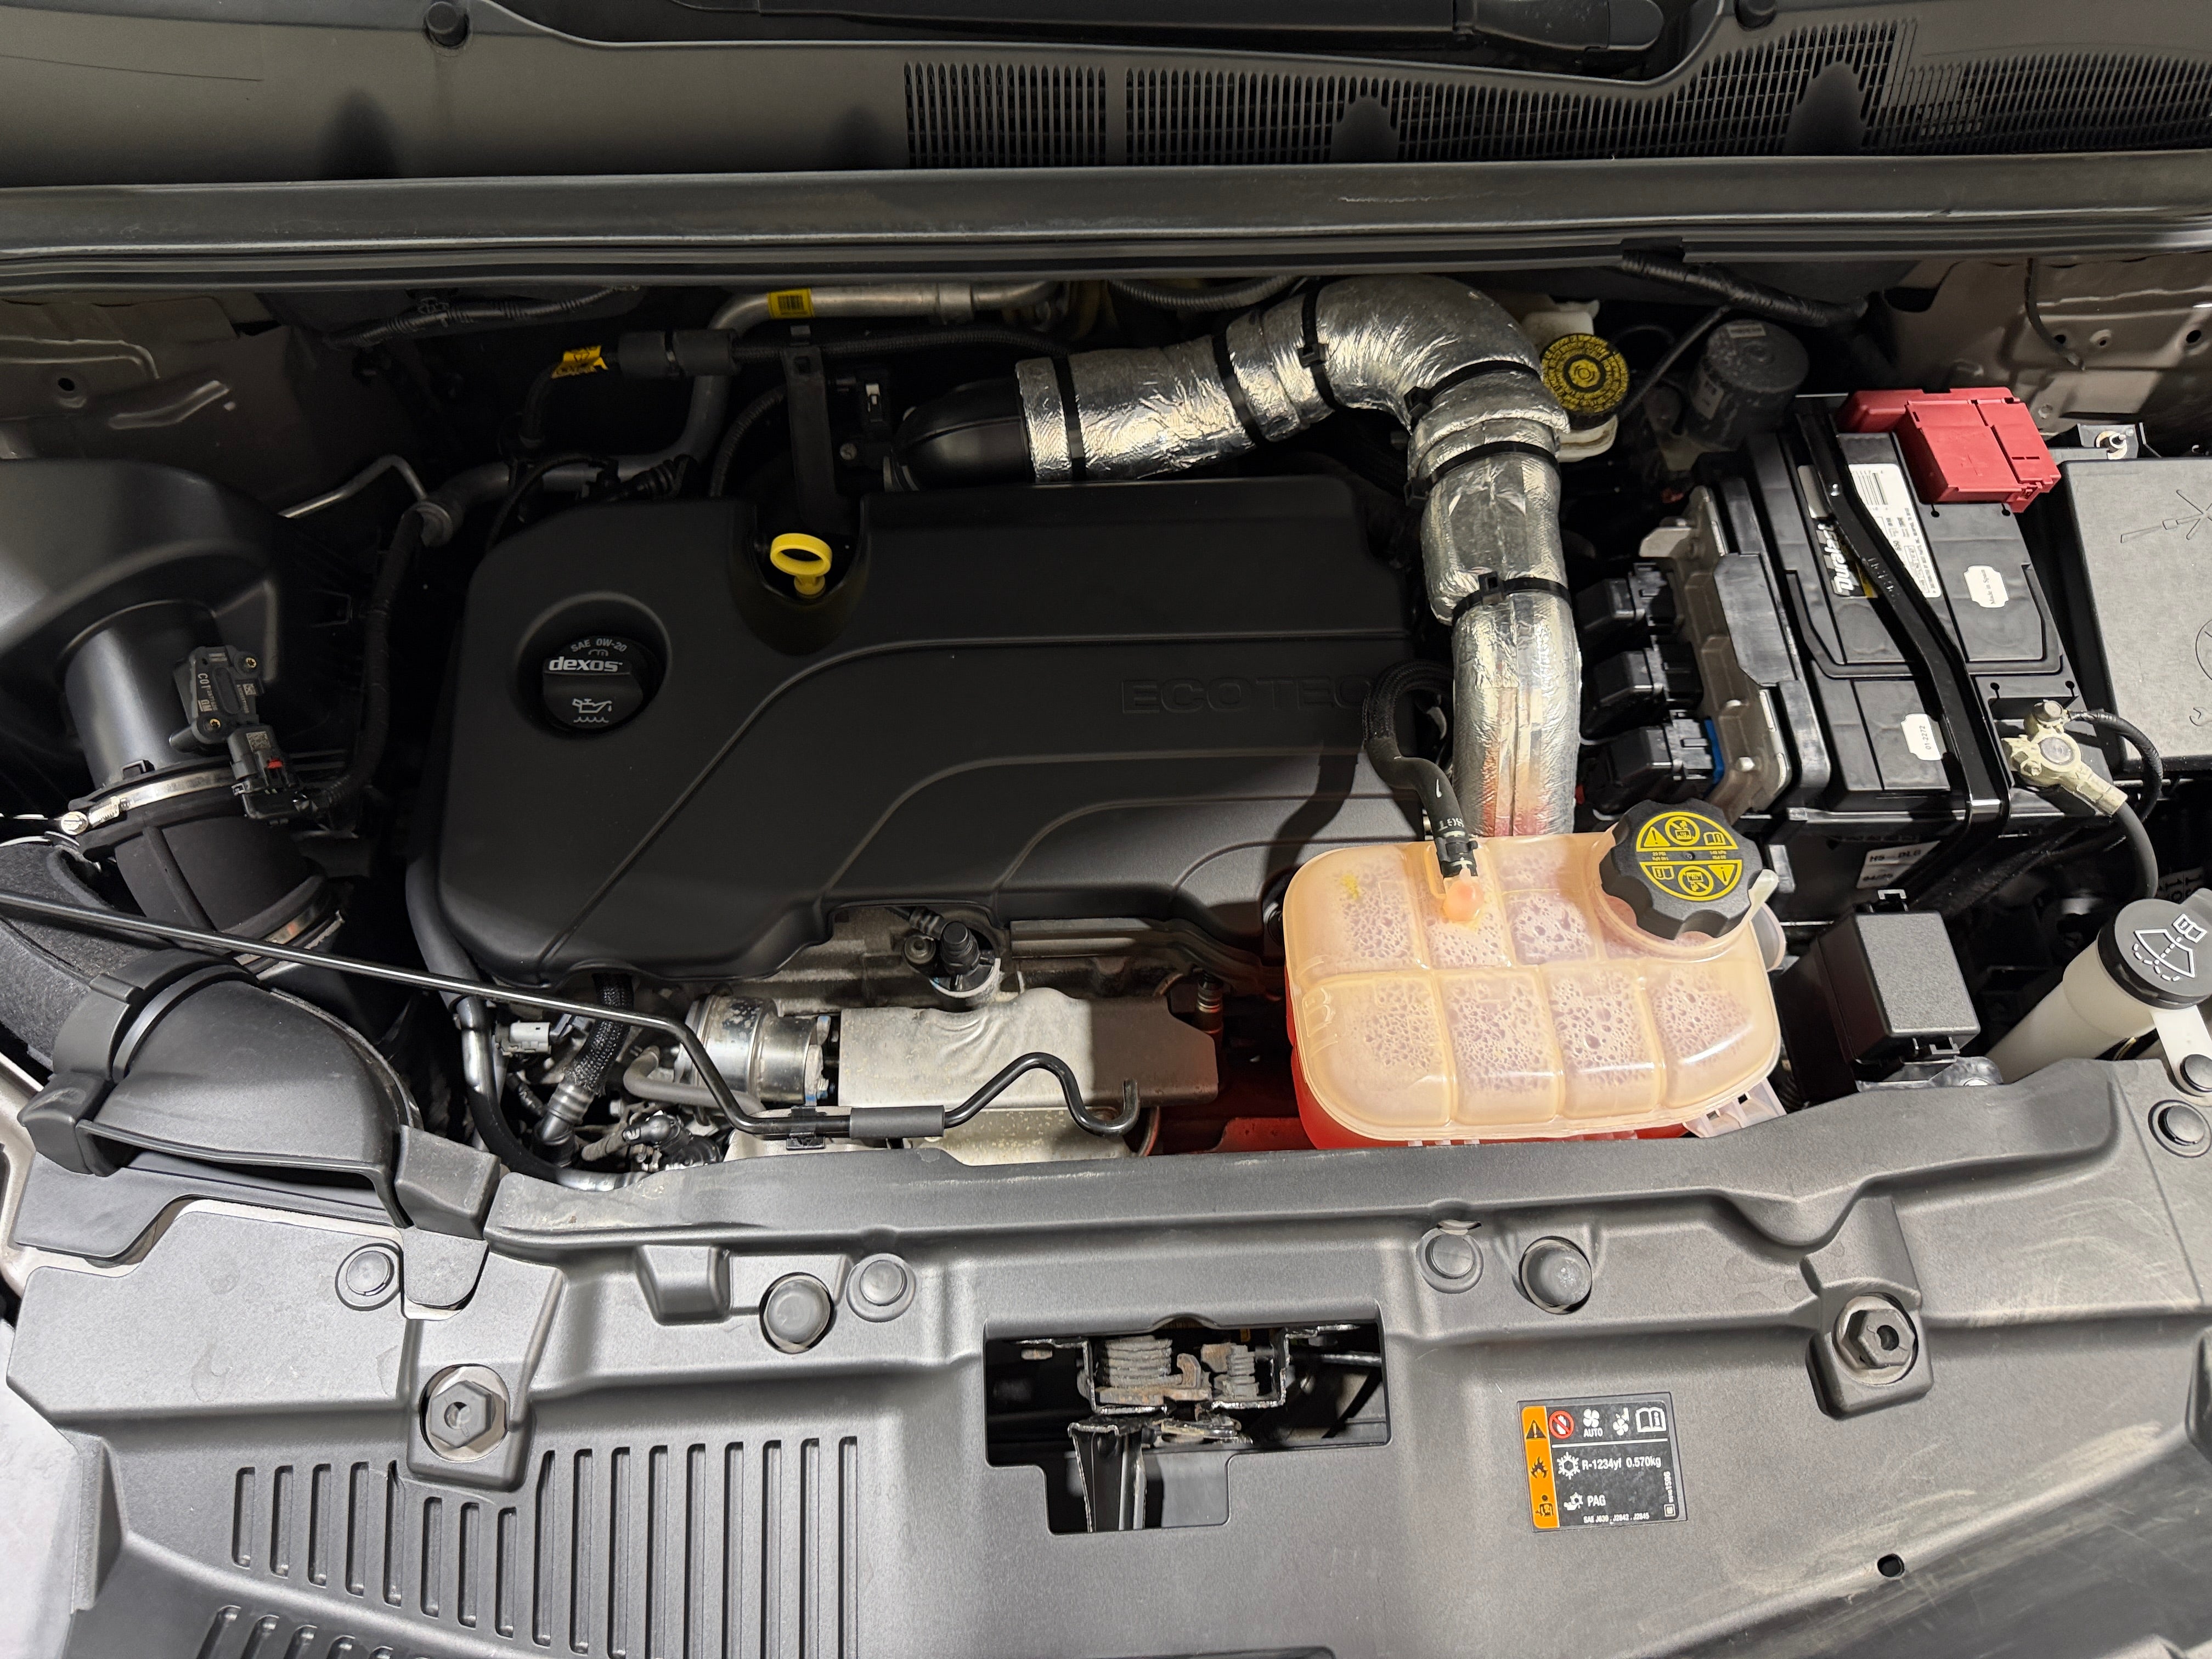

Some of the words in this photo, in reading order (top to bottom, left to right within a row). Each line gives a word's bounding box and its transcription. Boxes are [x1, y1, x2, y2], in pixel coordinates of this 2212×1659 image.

[1986, 590, 1996, 605] Made
[571, 639, 591, 652] SAE
[596, 638, 628, 652] 0W-20
[549, 656, 619, 672] dexos
[1121, 675, 1373, 714] ECOTEC
[197, 698, 213, 712] GM
[1919, 725, 1932, 750] 01-2272
[1583, 1427, 1603, 1437] AUTO
[1582, 1457, 1622, 1471] R-1234yf
[1626, 1456, 1662, 1468] 0.570kg
[1587, 1495, 1606, 1507] PAG
